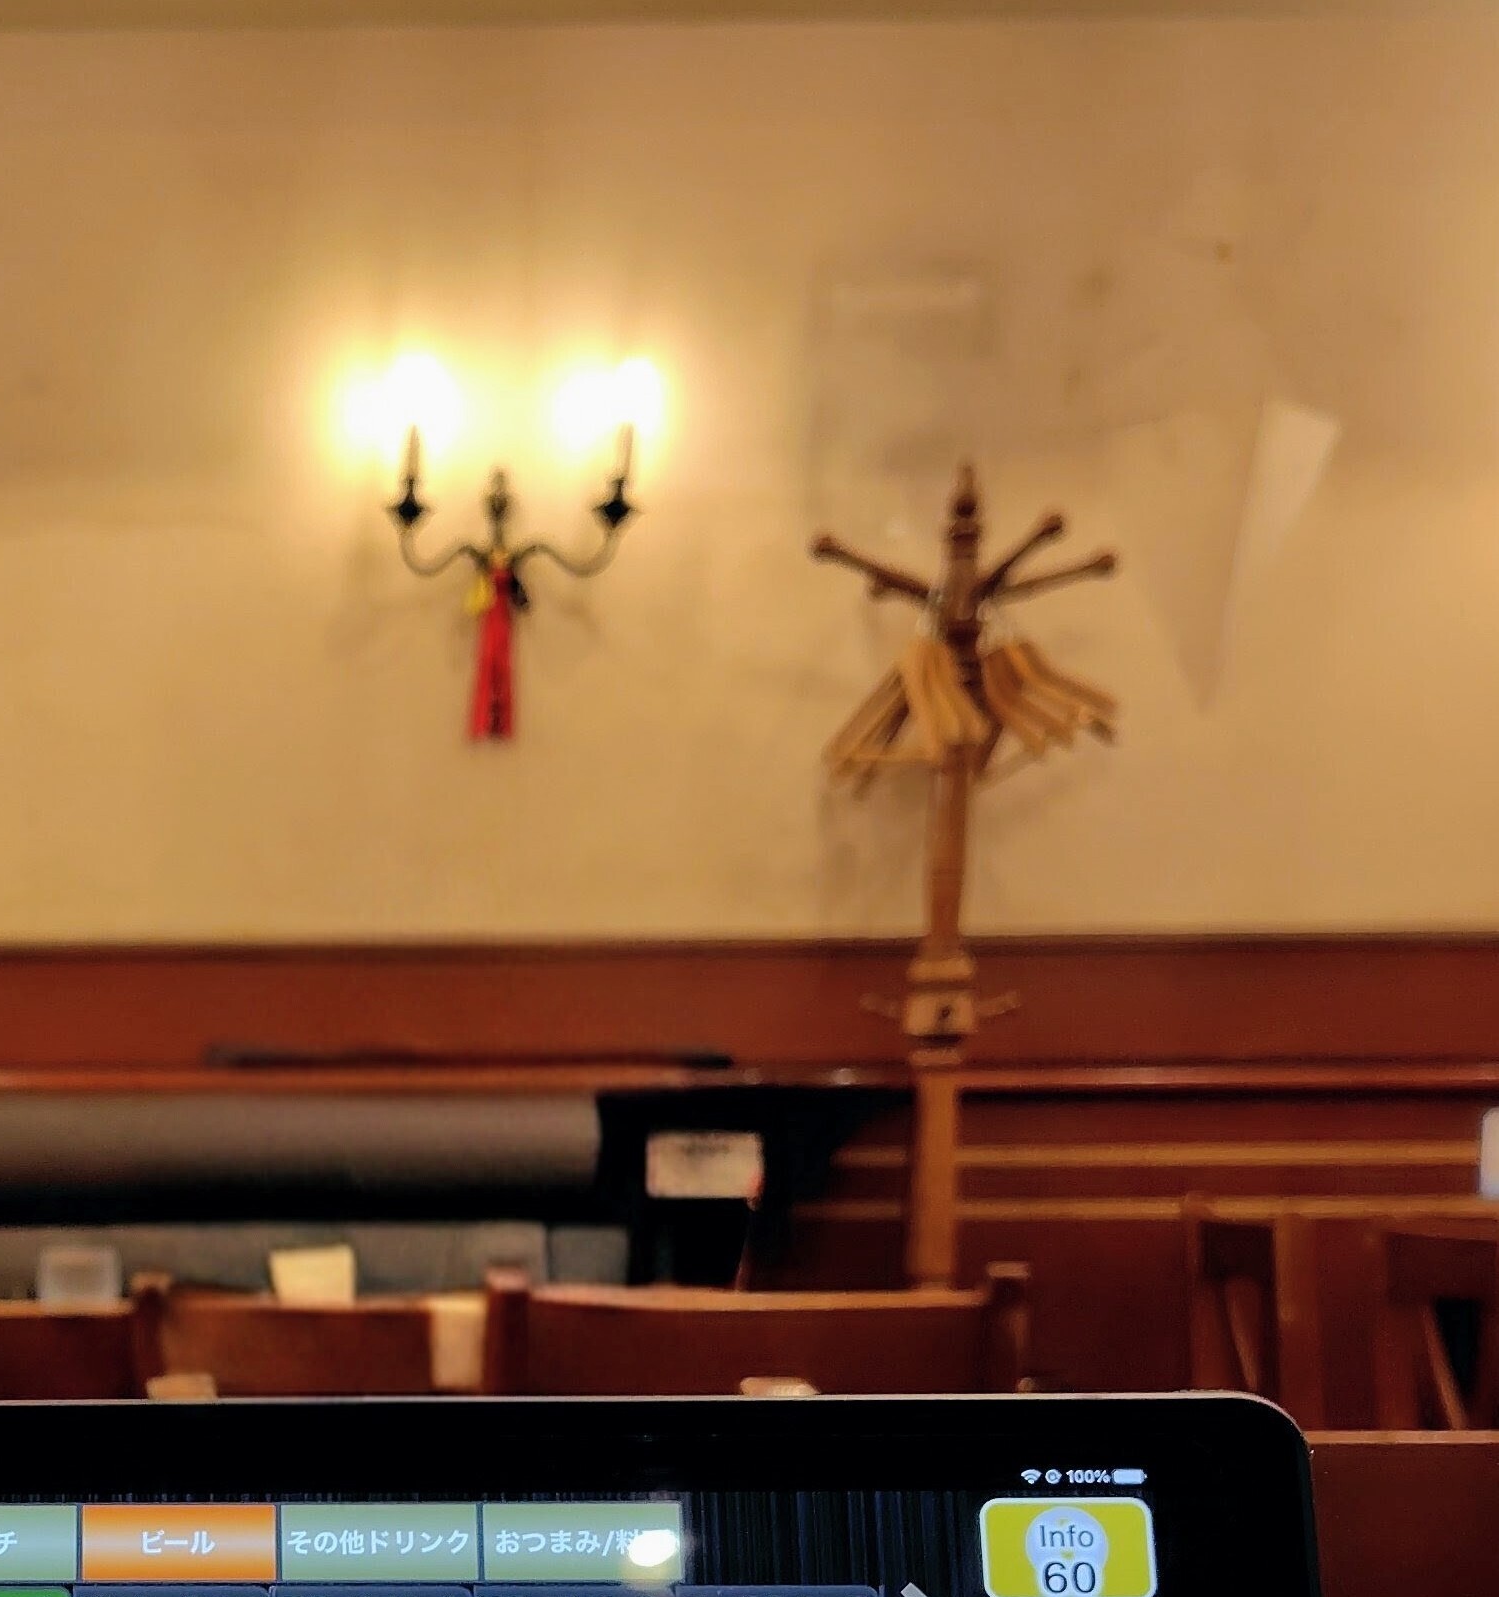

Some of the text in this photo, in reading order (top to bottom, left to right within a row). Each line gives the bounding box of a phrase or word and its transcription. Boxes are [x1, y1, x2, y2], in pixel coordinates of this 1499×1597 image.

[1065, 1469, 1112, 1484] 100%
[140, 1530, 216, 1556] ビール
[286, 1528, 470, 1556] その他ドリンク
[495, 1528, 679, 1557] おつまみ/料
[1038, 1523, 1095, 1549] Info
[1043, 1561, 1097, 1594] 60
